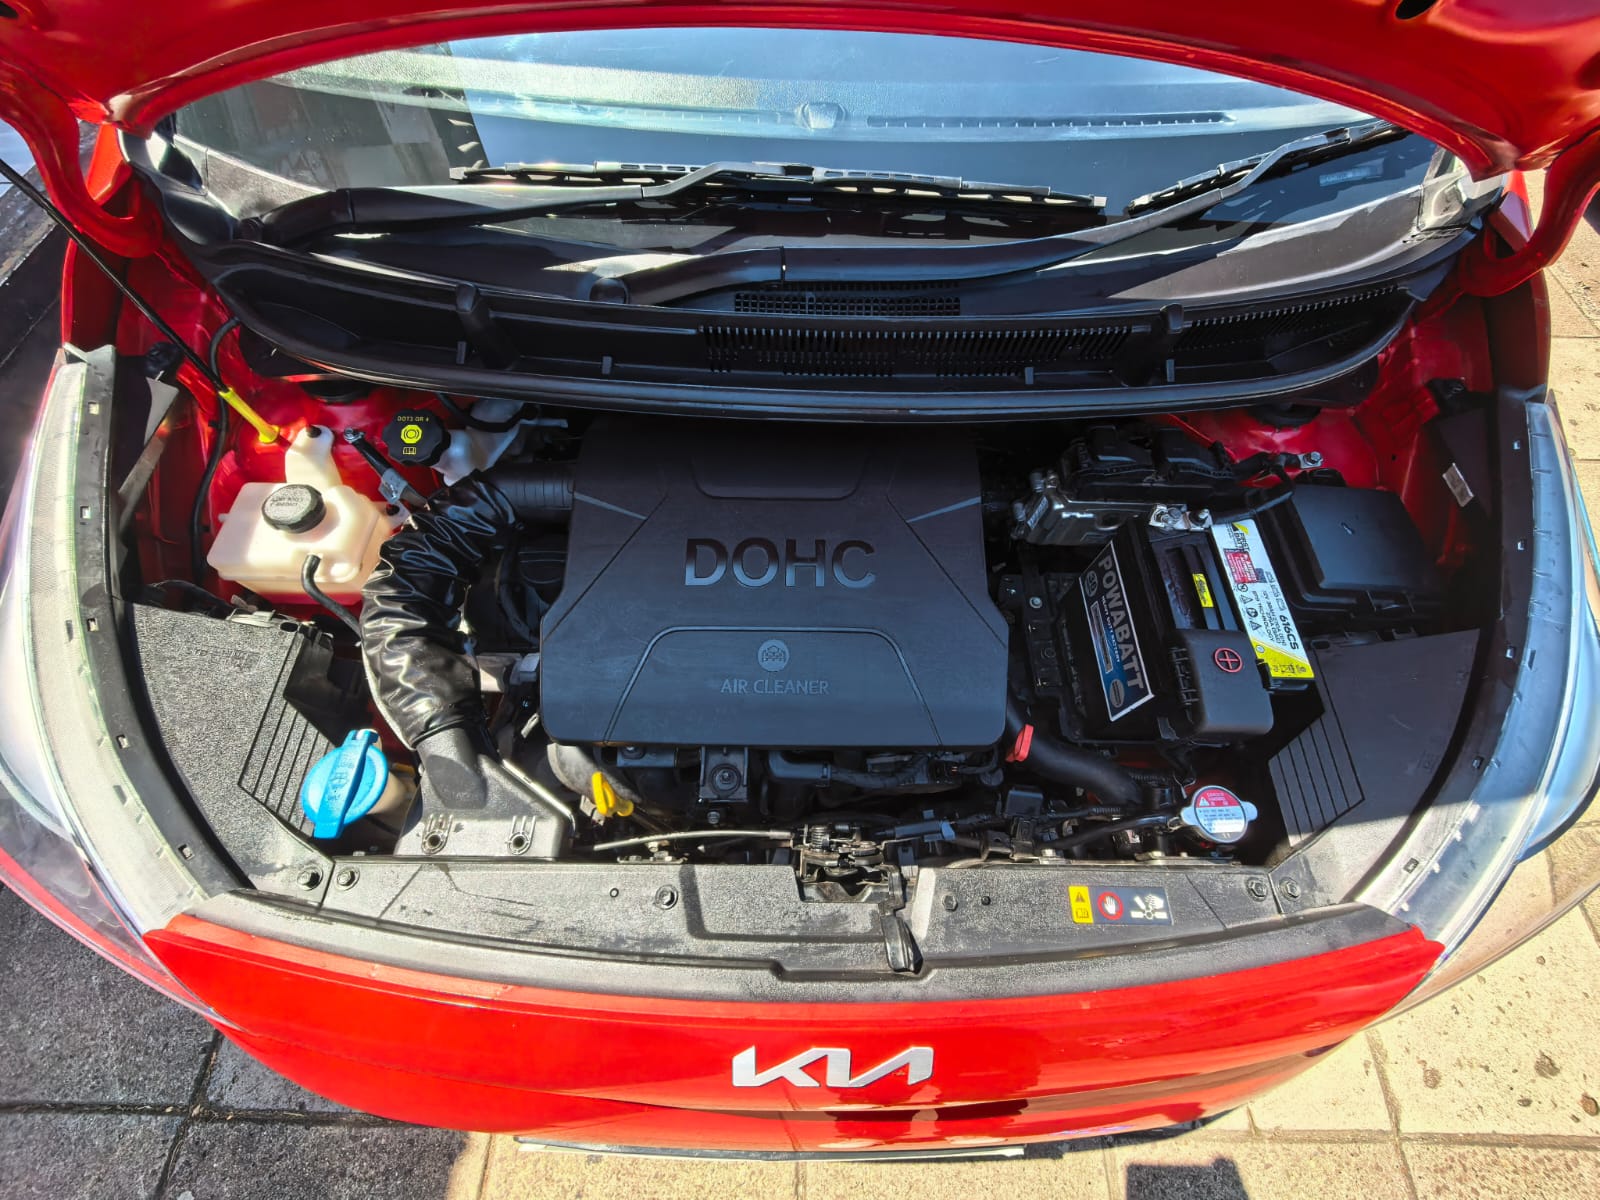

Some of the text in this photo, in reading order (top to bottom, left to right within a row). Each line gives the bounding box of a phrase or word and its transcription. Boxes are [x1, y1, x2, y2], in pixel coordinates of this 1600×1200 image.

[685, 537, 876, 588] DOHC
[1098, 554, 1145, 690] POWABATT
[1258, 603, 1275, 641] TECHNOLOGY
[1279, 614, 1300, 650] 616CS
[720, 679, 830, 695] AIR CLEANER
[732, 1045, 934, 1088] KIA
